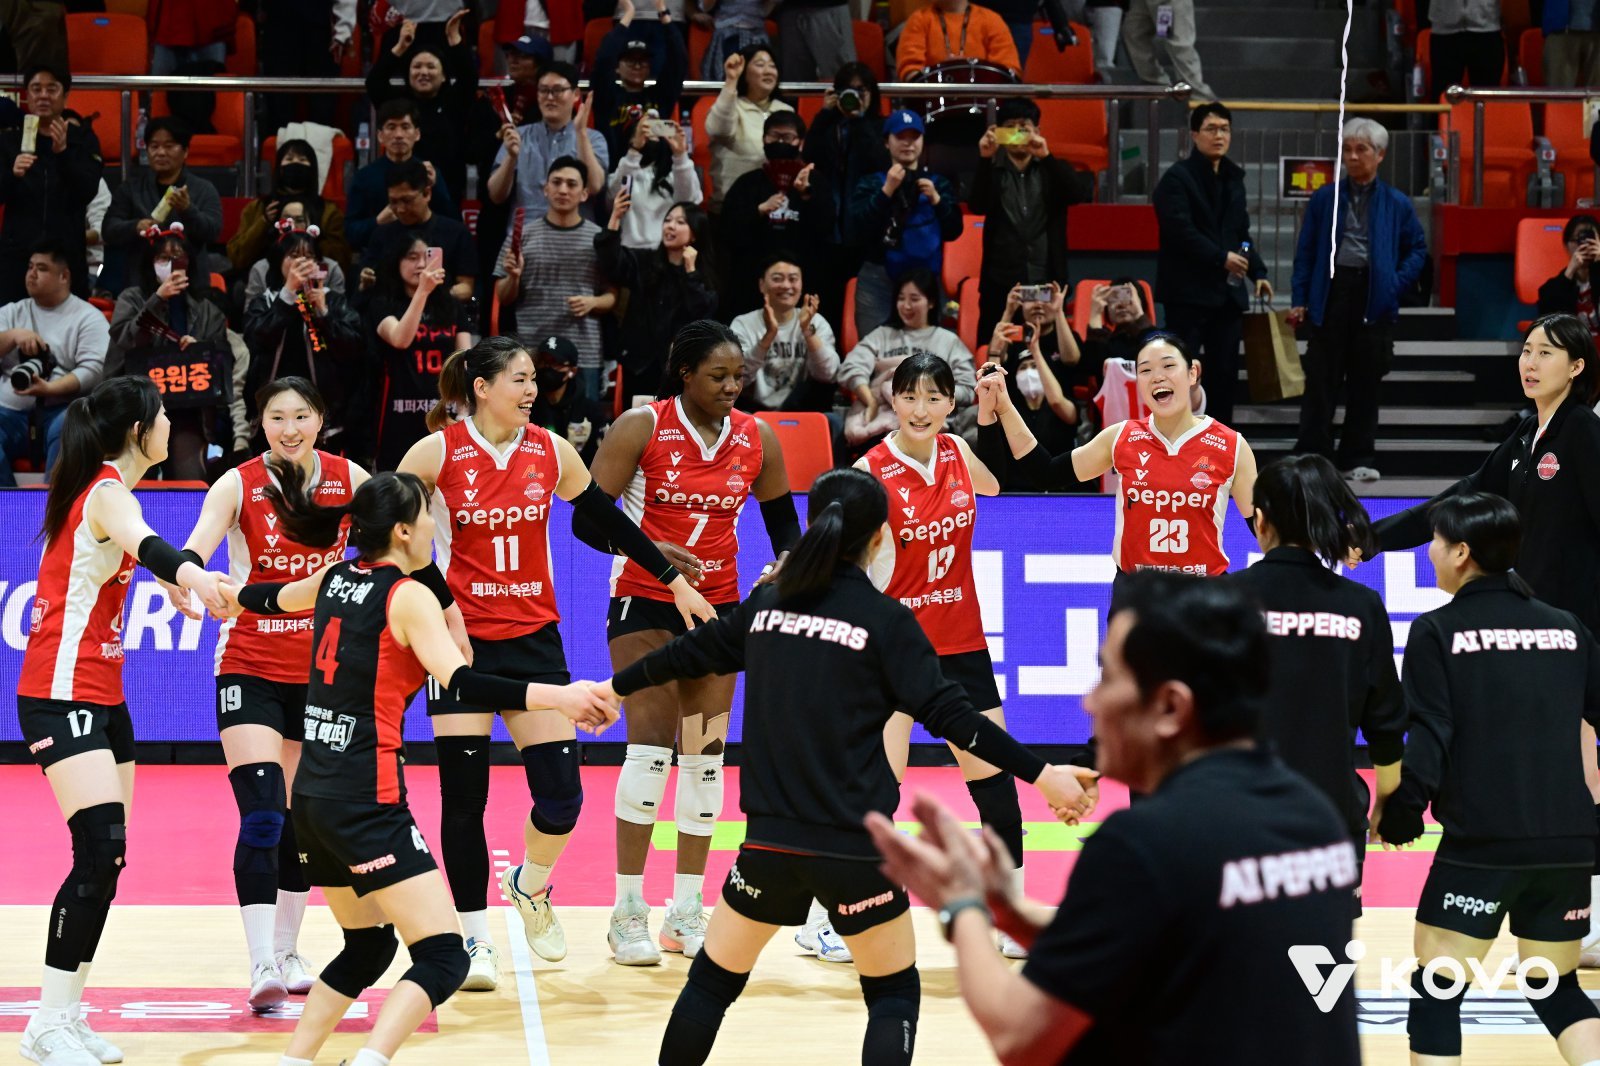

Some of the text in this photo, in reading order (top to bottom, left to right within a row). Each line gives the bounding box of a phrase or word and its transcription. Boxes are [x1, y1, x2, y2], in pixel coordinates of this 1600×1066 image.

[520, 445, 546, 456] COFFEE
[523, 440, 543, 449] EDIYA
[1200, 437, 1228, 451] COFFEE
[1205, 433, 1226, 444] EDIYA
[452, 450, 479, 461] COFFEE
[880, 462, 900, 473] EDIYA
[661, 481, 679, 489] KOVO
[882, 466, 906, 480] COFFEE
[654, 488, 743, 511] pepper
[1127, 487, 1212, 513] pepper
[456, 504, 546, 531] pepper
[685, 513, 710, 547] 7
[899, 508, 974, 549] pepper
[1149, 518, 1189, 554] 23
[257, 546, 342, 576] pepper
[491, 535, 519, 572] 11
[927, 544, 955, 583] 13
[326, 574, 375, 605] 한다혜
[471, 582, 543, 597] 페퍼저축은행
[620, 596, 632, 621] 7
[257, 617, 314, 633] 페퍼저축
[750, 609, 869, 651] AI PEPPERS
[1264, 610, 1362, 641] EPPERS
[315, 617, 342, 685] 4
[1452, 629, 1577, 654] AI PEPPERS
[219, 685, 242, 714] 19
[428, 675, 441, 701] 11
[66, 709, 93, 738] 17
[410, 825, 430, 854] 4
[1219, 840, 1359, 908] AI PEPPER
[848, 890, 894, 915] PEPPERS
[1443, 892, 1501, 917] pepper
